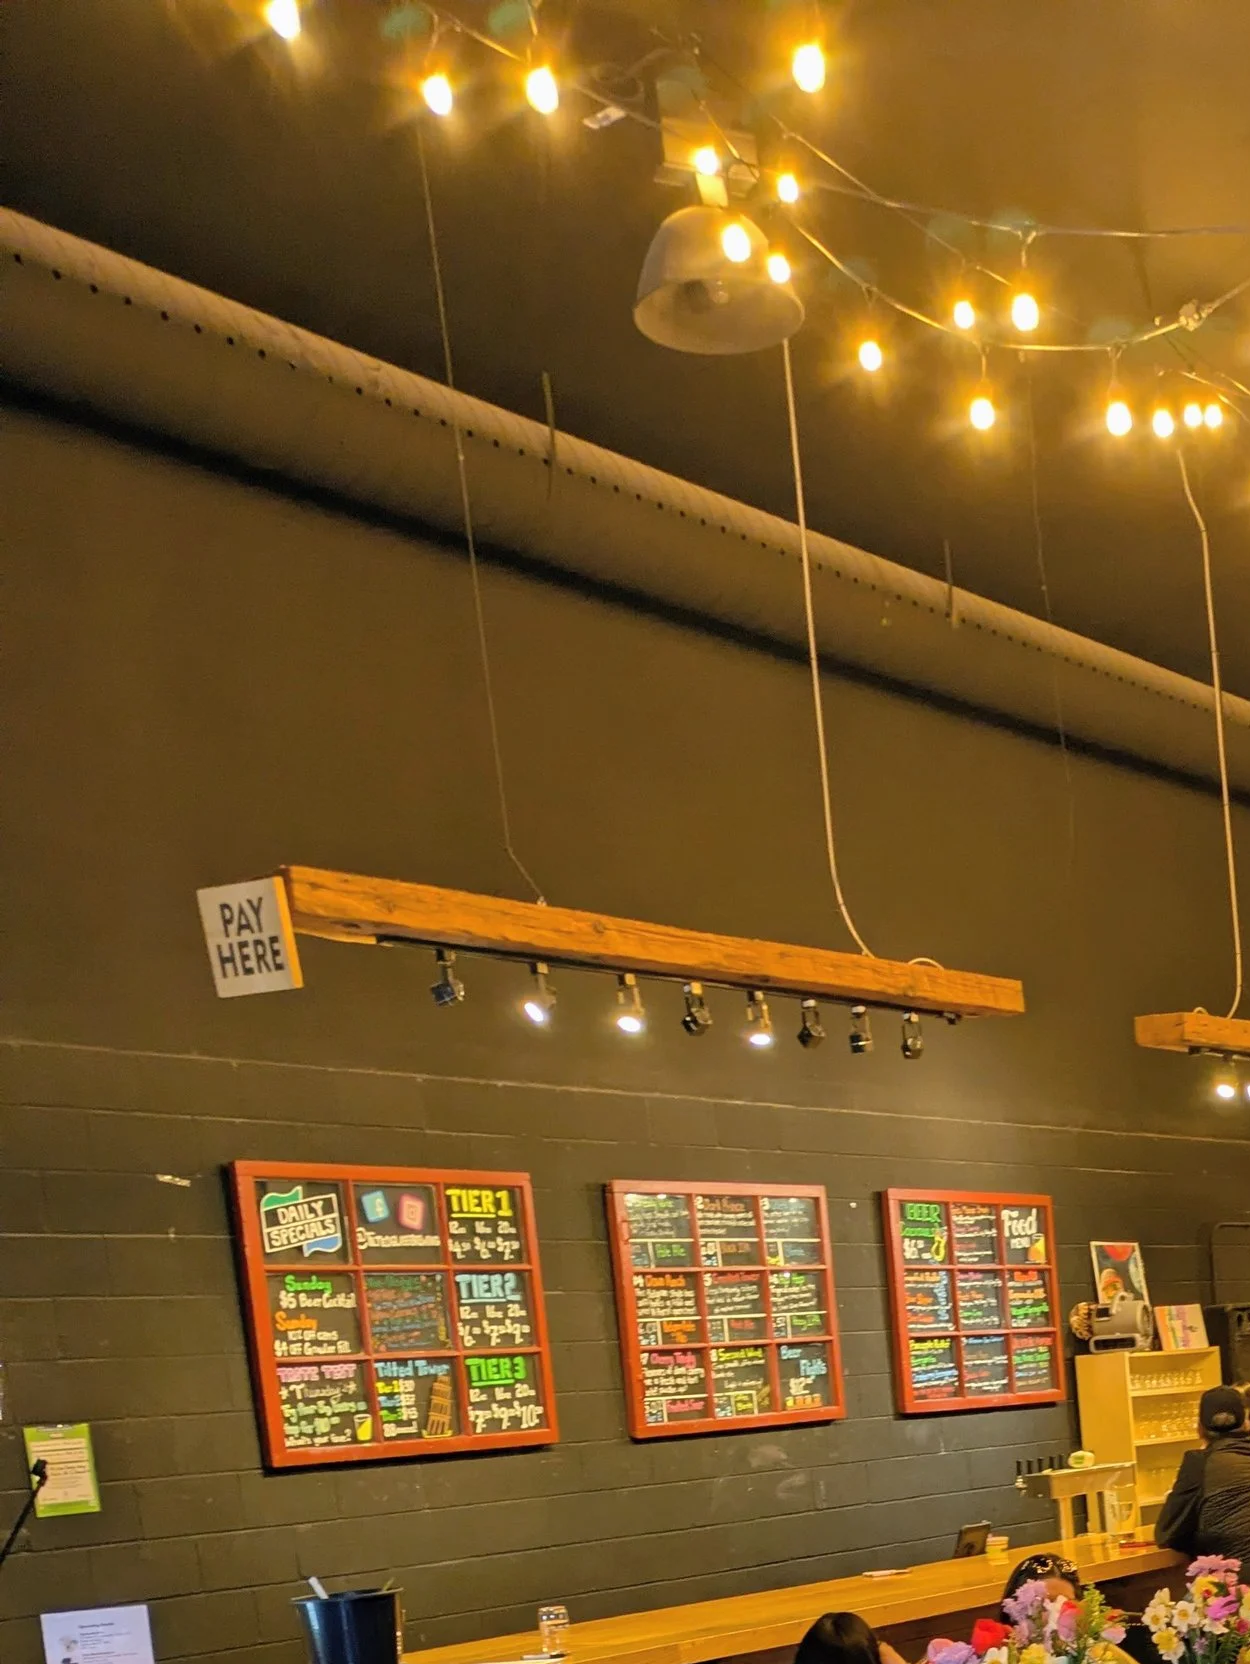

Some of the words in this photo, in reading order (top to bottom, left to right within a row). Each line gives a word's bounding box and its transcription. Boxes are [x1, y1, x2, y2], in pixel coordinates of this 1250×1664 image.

[219, 897, 263, 938] PAY
[216, 936, 285, 979] HERE
[277, 1200, 324, 1225] DAILY
[445, 1189, 496, 1213] TIER
[496, 1190, 513, 1217] 1
[695, 1196, 705, 1210] 2
[905, 1203, 941, 1222] BEER
[270, 1219, 336, 1247] SPECIALS
[455, 1274, 505, 1299] TIER
[504, 1272, 523, 1301] 2
[374, 1360, 414, 1378] Tilted
[465, 1357, 513, 1381] TIER
[513, 1355, 527, 1380] 3
